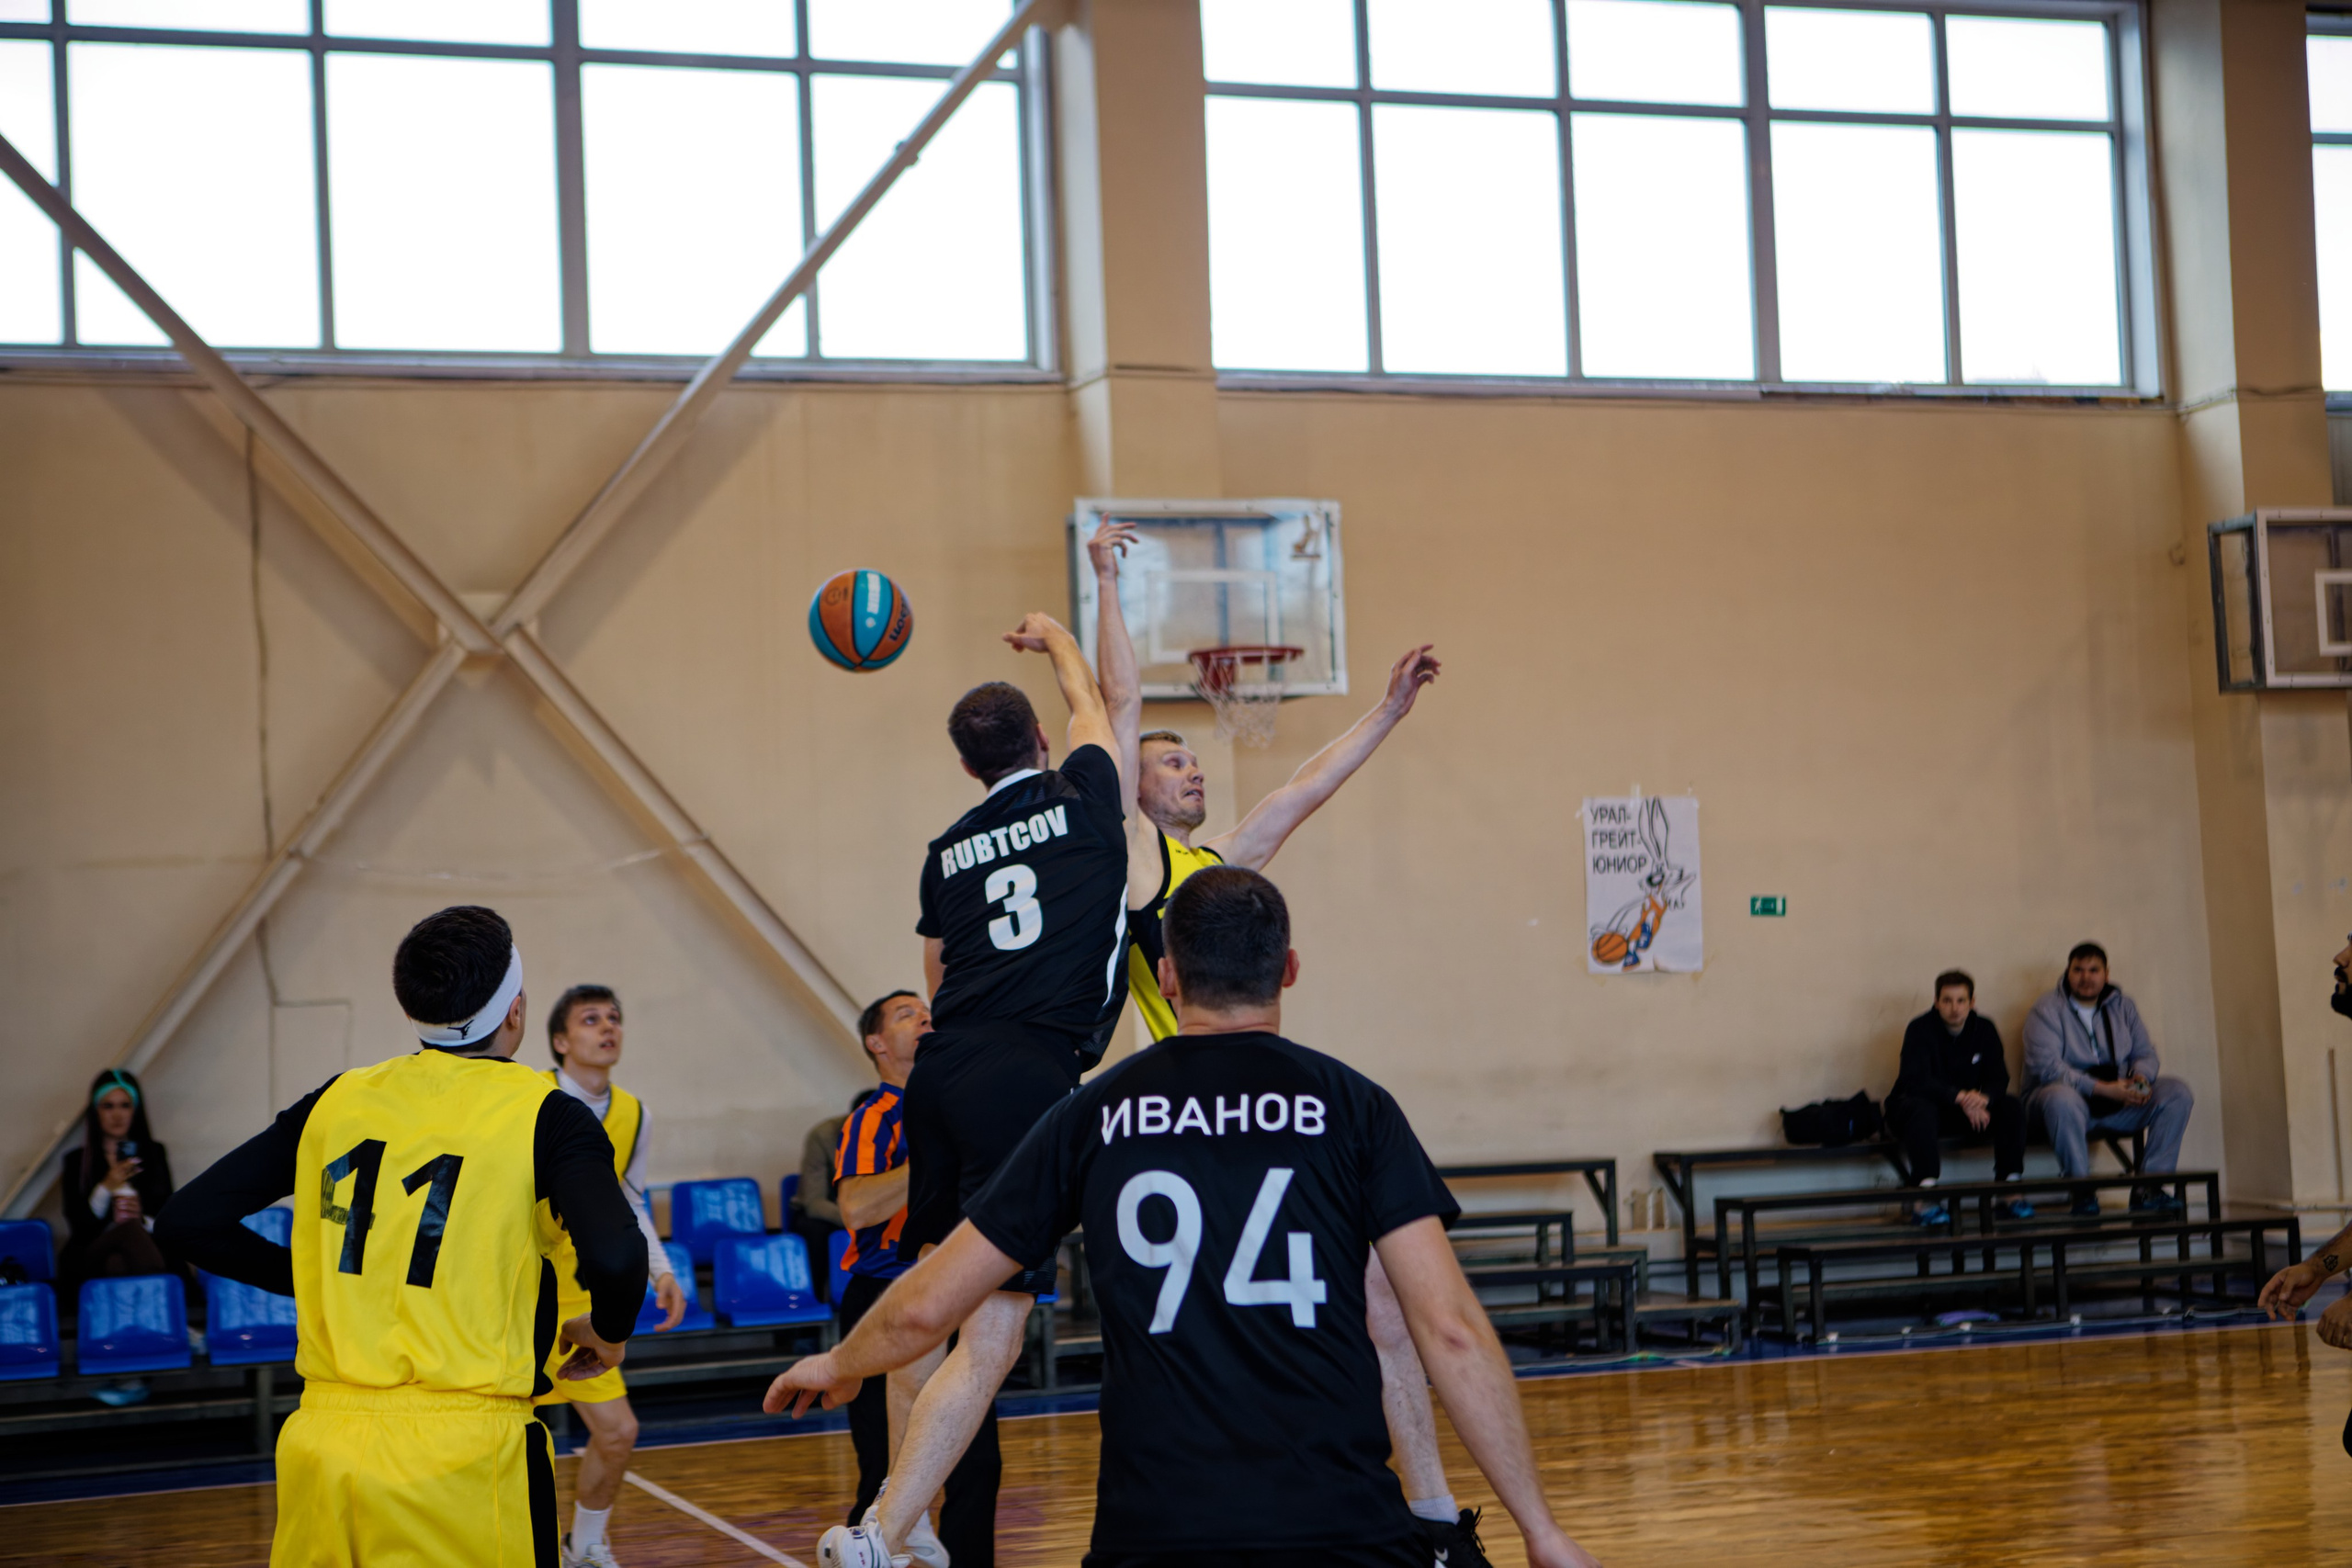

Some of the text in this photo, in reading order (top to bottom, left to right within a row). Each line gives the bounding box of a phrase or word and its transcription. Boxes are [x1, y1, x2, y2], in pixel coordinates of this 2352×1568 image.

[1589, 806, 1632, 824] УРАЛ-
[1591, 828, 1642, 849] ГРЕЙТ-
[941, 805, 1068, 879] RUBTCOV
[1592, 854, 1647, 874] ЮНИОР
[985, 863, 1043, 950] 3
[1102, 1093, 1326, 1145] ИВАНОВ
[1116, 1168, 1327, 1334] 94
